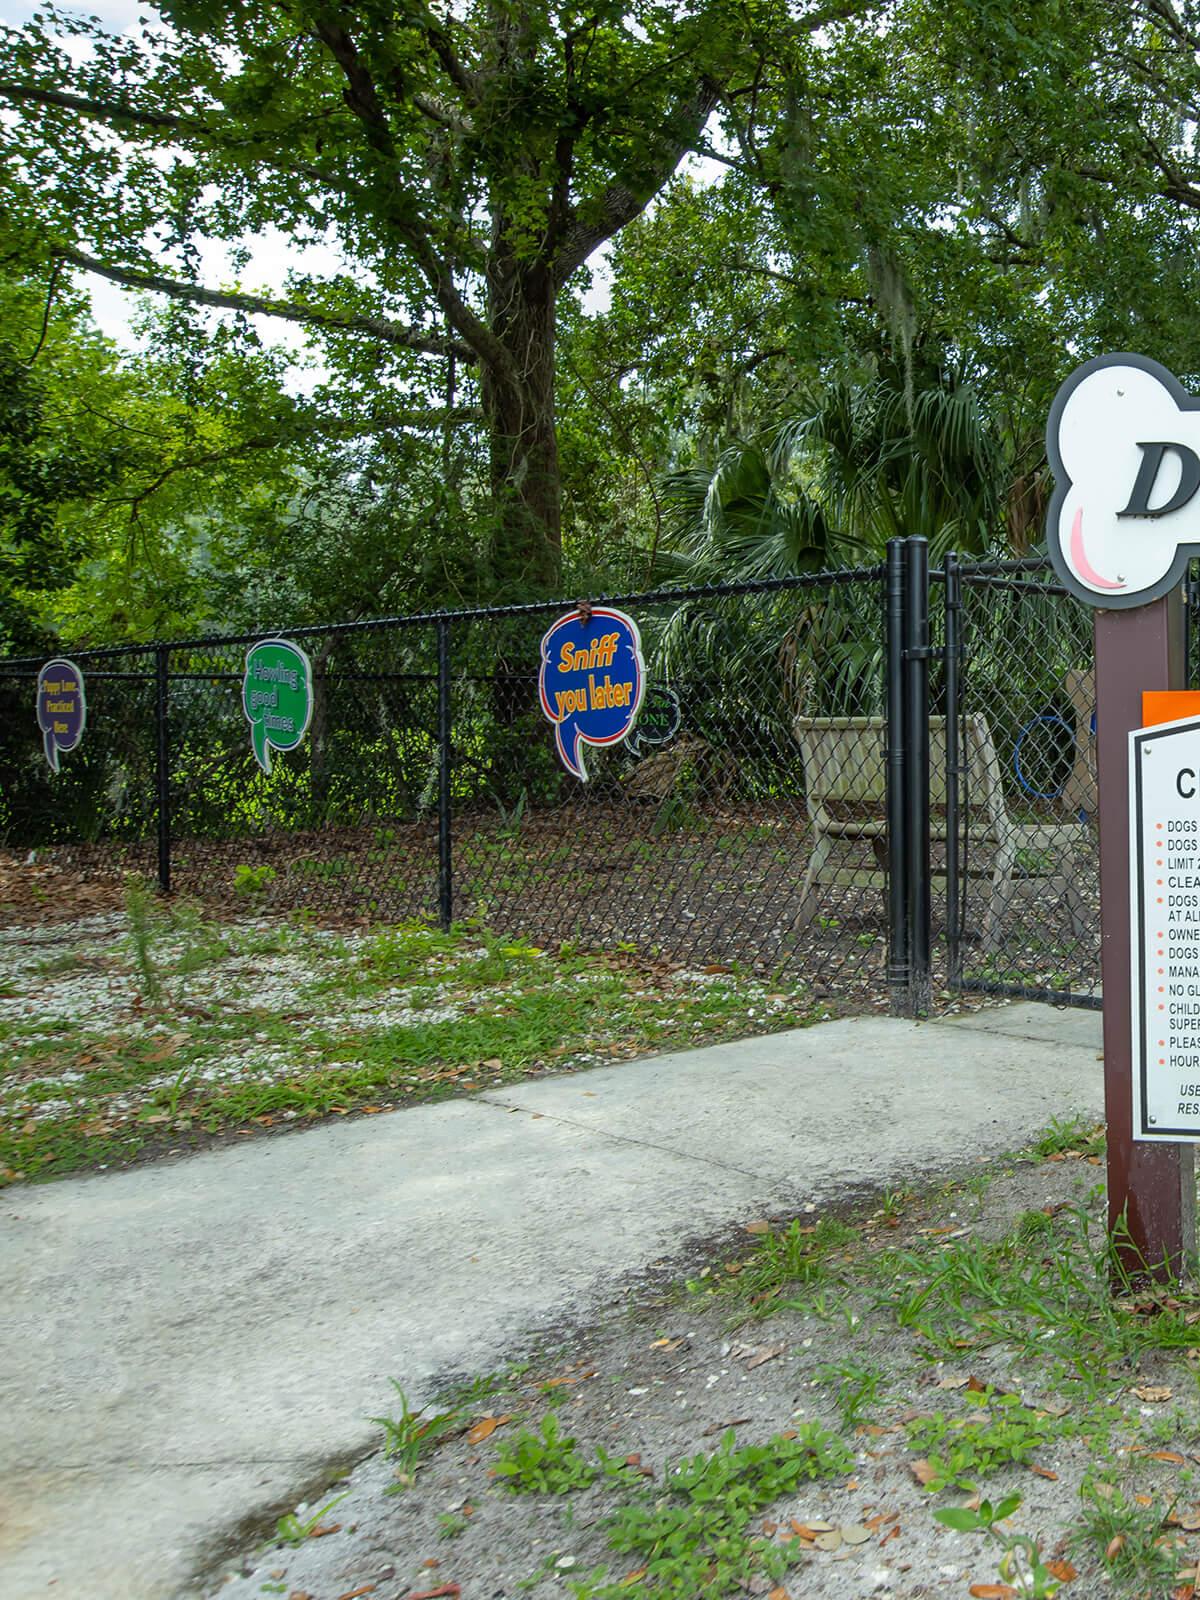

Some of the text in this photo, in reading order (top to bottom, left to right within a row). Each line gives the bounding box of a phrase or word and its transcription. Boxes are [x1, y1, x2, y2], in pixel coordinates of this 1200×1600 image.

[557, 631, 620, 673] Sniff
[253, 658, 298, 690] Howling
[250, 684, 278, 709] good
[554, 687, 588, 721] you
[588, 673, 632, 711] later
[1167, 820, 1197, 832] DOGS
[1167, 839, 1198, 851] DOGS
[1167, 857, 1194, 869] LIMIT
[1168, 894, 1198, 907] DOGS
[1168, 910, 1181, 922] AT
[1168, 947, 1199, 959] DOGS
[1169, 984, 1184, 996] NO
